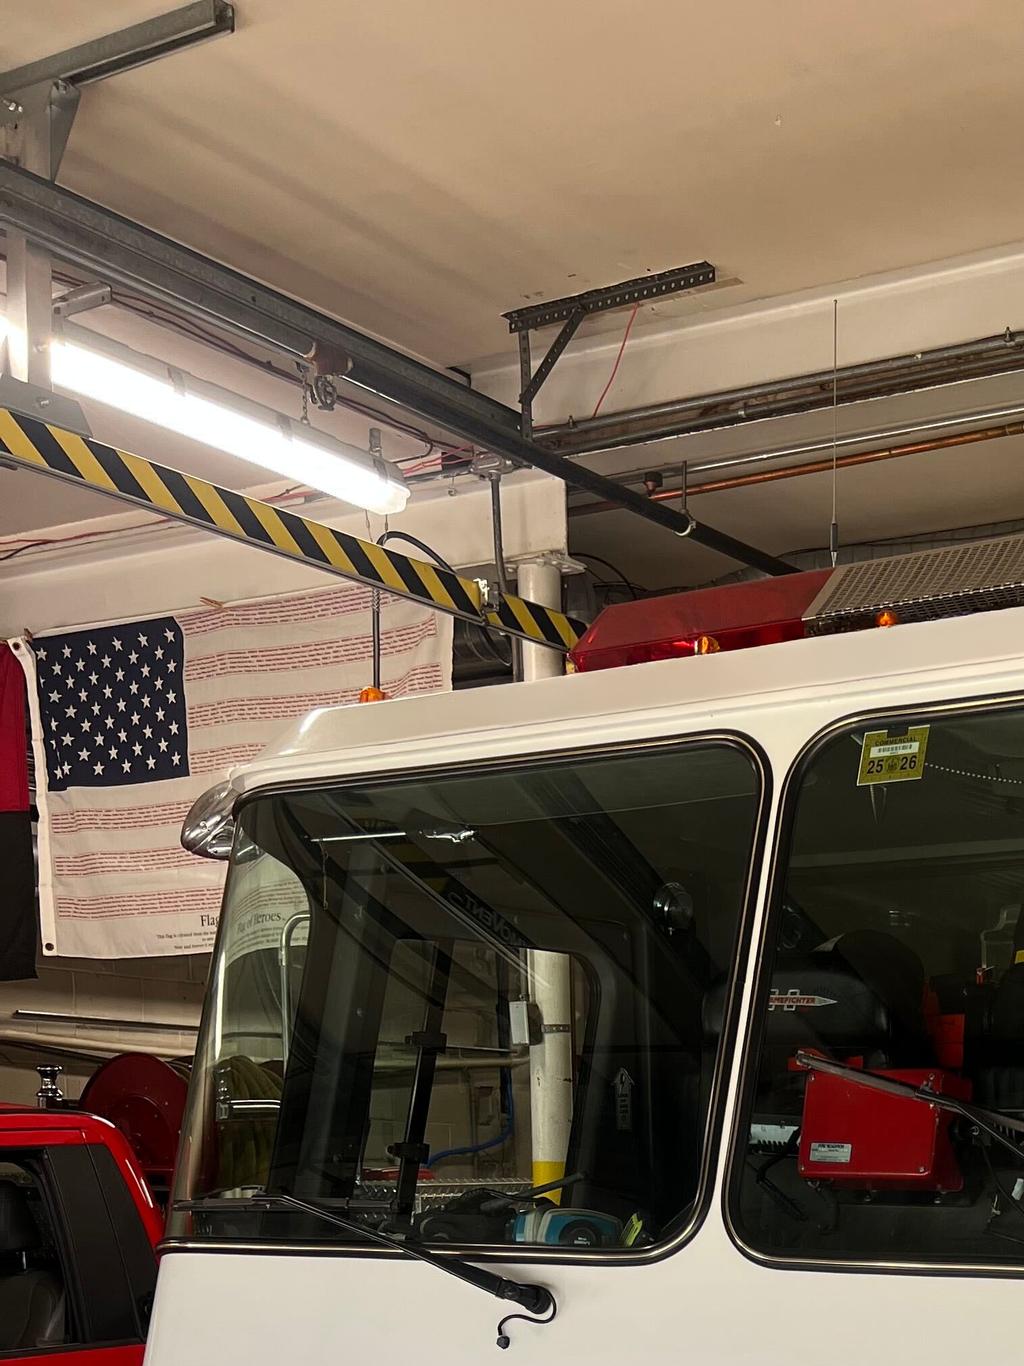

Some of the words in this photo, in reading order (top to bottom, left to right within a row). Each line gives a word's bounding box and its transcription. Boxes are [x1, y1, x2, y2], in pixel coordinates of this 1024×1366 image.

[875, 736, 918, 746] COMMERCIAL
[867, 759, 884, 774] 25
[900, 755, 917, 770] 26
[769, 997, 816, 1005] AMEFIGHTER
